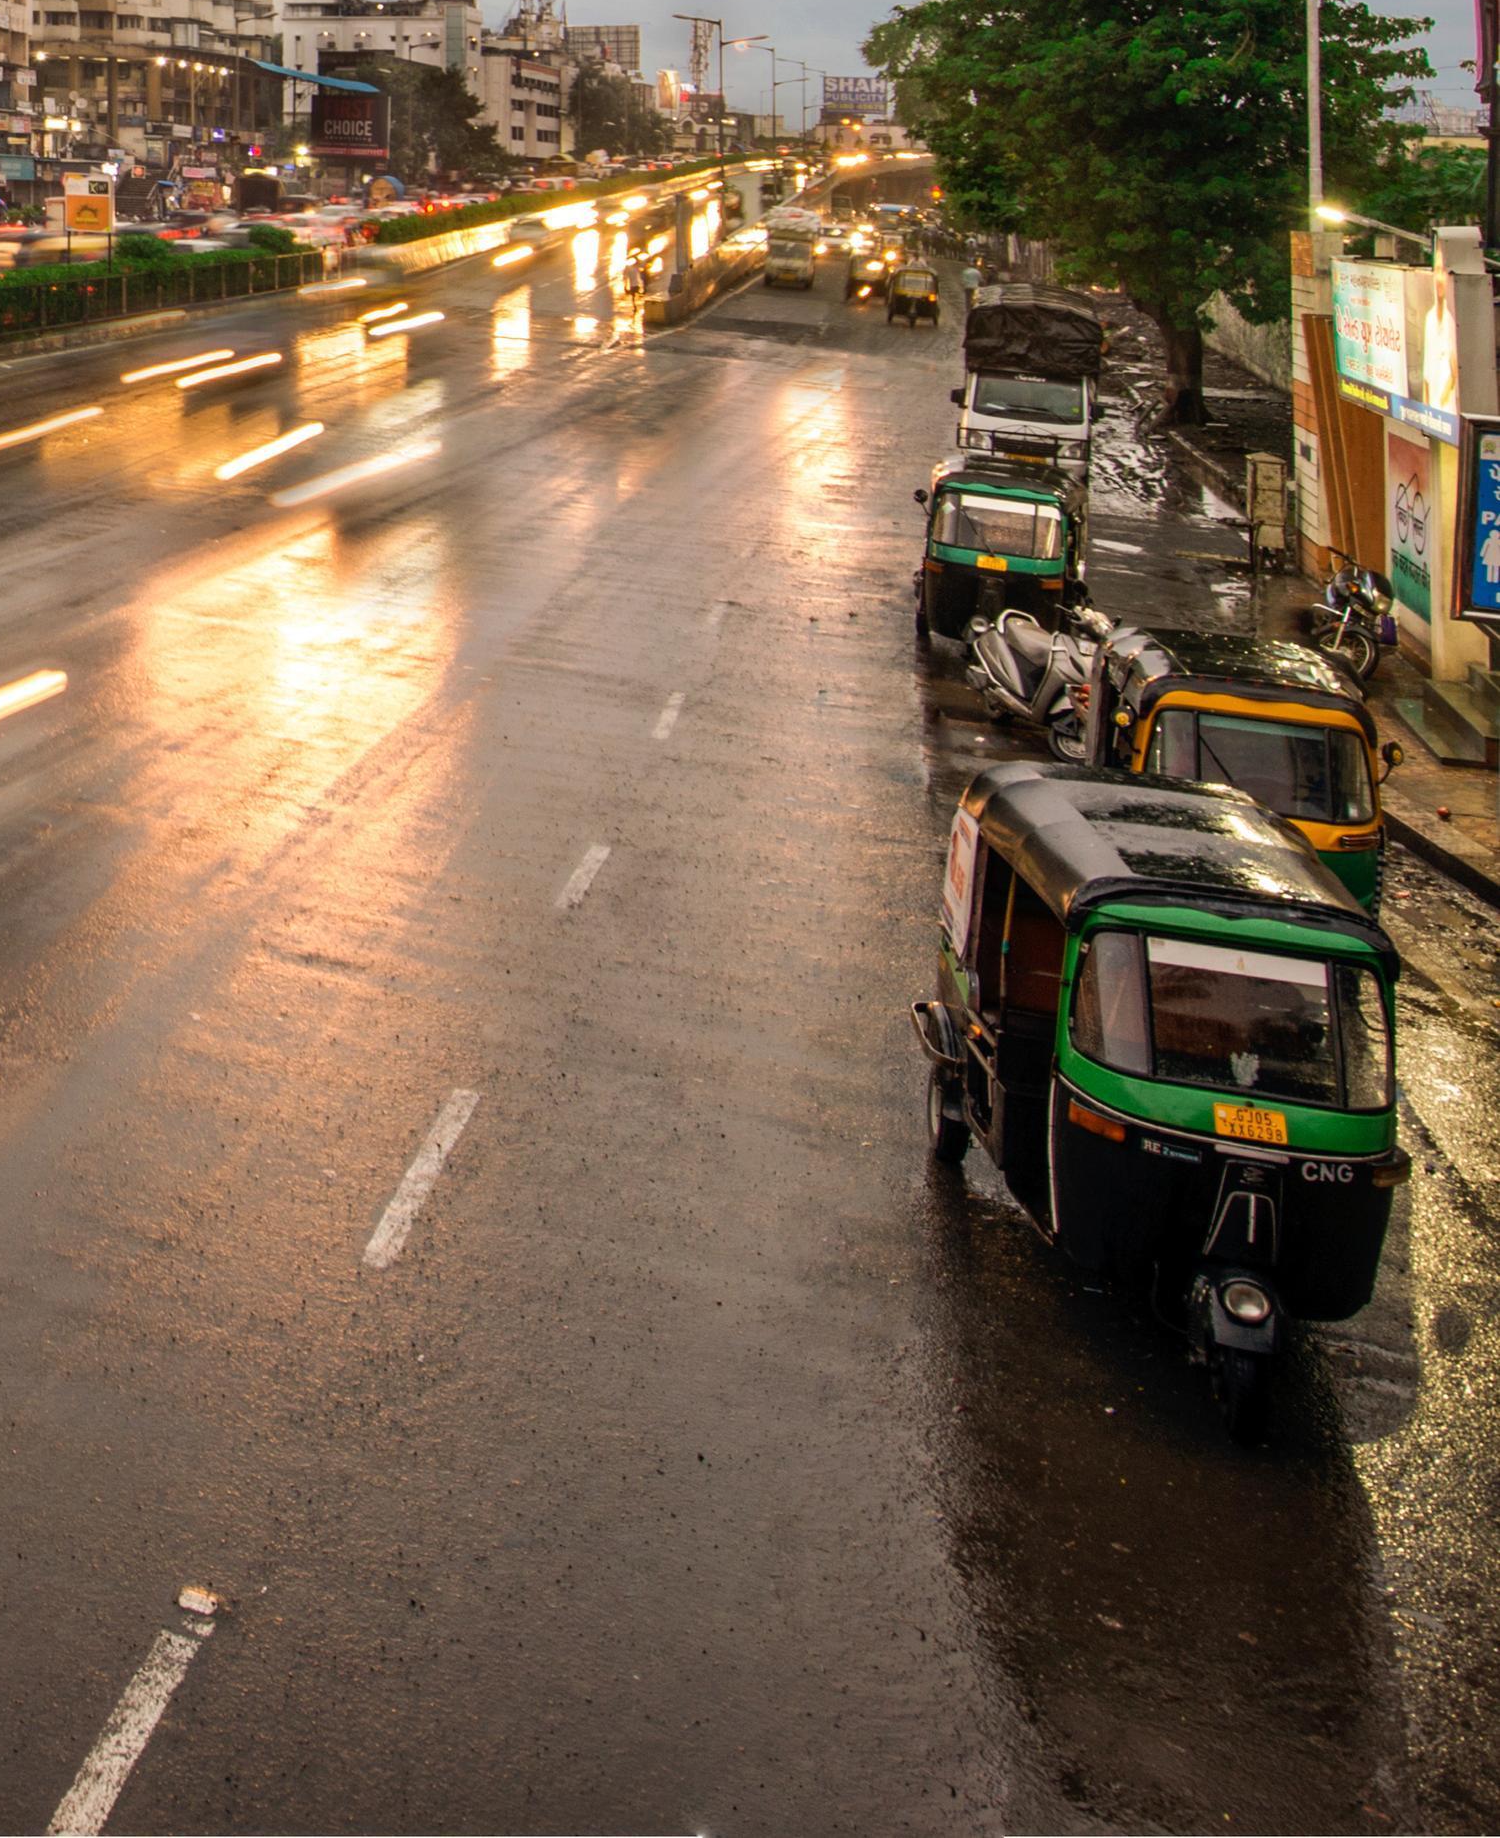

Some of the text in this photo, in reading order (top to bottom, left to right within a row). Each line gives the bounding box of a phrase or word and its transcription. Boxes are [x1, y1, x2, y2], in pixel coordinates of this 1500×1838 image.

[825, 78, 885, 93] SHAH
[825, 93, 886, 101] PUBLICITY
[324, 119, 373, 136] CHOICE
[1143, 1139, 1161, 1154] RE
[1301, 1161, 1354, 1183] CNG
